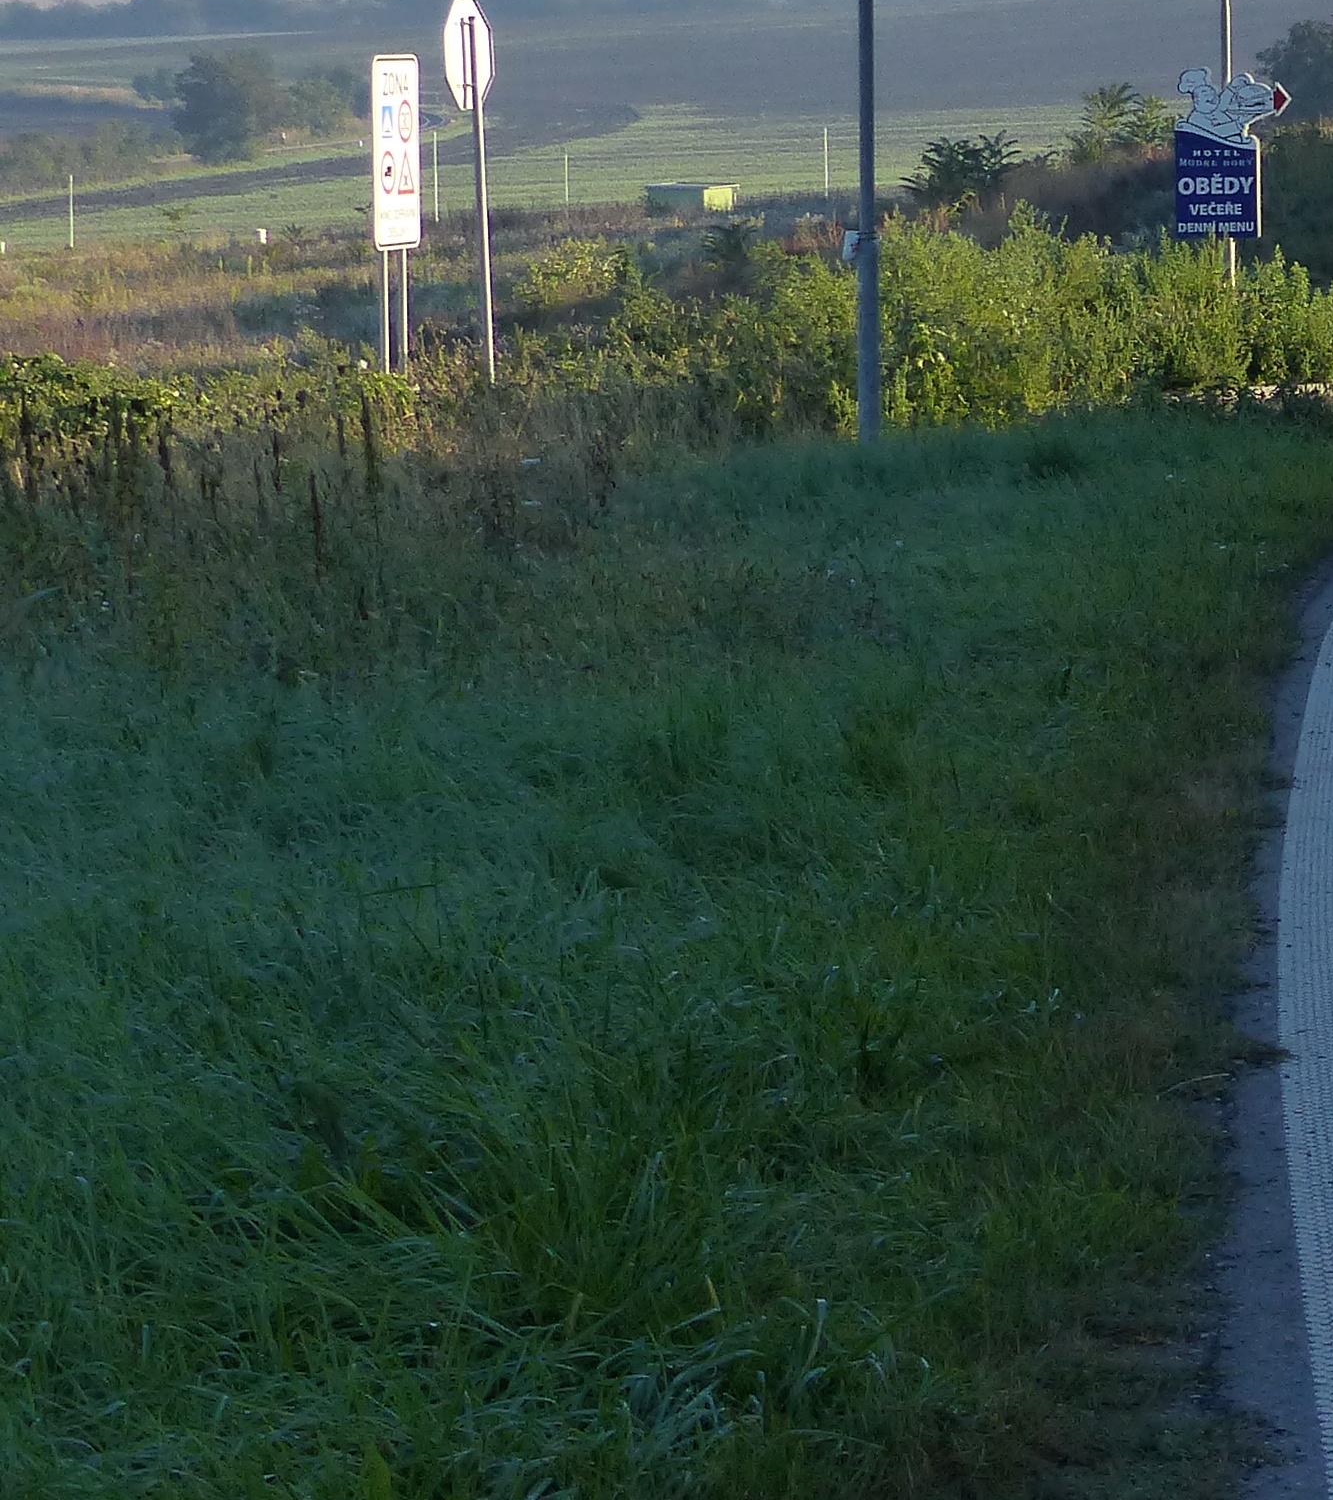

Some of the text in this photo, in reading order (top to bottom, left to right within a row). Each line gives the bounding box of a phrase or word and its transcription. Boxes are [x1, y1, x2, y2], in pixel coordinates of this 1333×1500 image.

[382, 72, 410, 95] ZONA
[1193, 149, 1240, 157] HOTEL
[1178, 173, 1254, 195] OBĚDY
[1189, 201, 1242, 215] VEČEŘE
[1177, 221, 1254, 233] DENNÍ MENU
